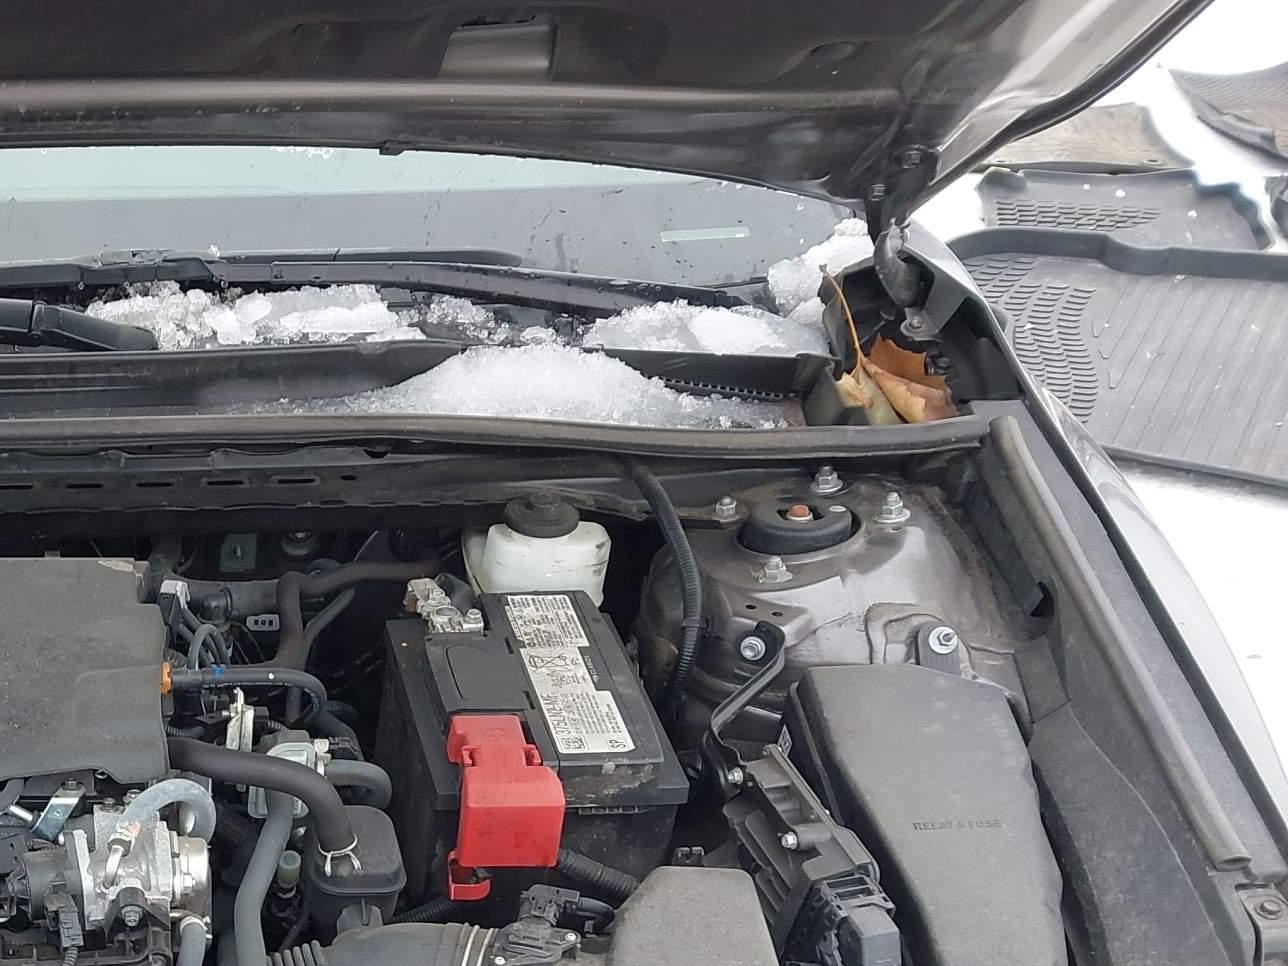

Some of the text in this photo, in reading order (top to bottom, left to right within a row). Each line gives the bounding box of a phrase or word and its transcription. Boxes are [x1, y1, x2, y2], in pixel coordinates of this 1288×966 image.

[609, 739, 627, 750] SP
[912, 820, 953, 832] RELAY
[968, 818, 1002, 831] FUSE
